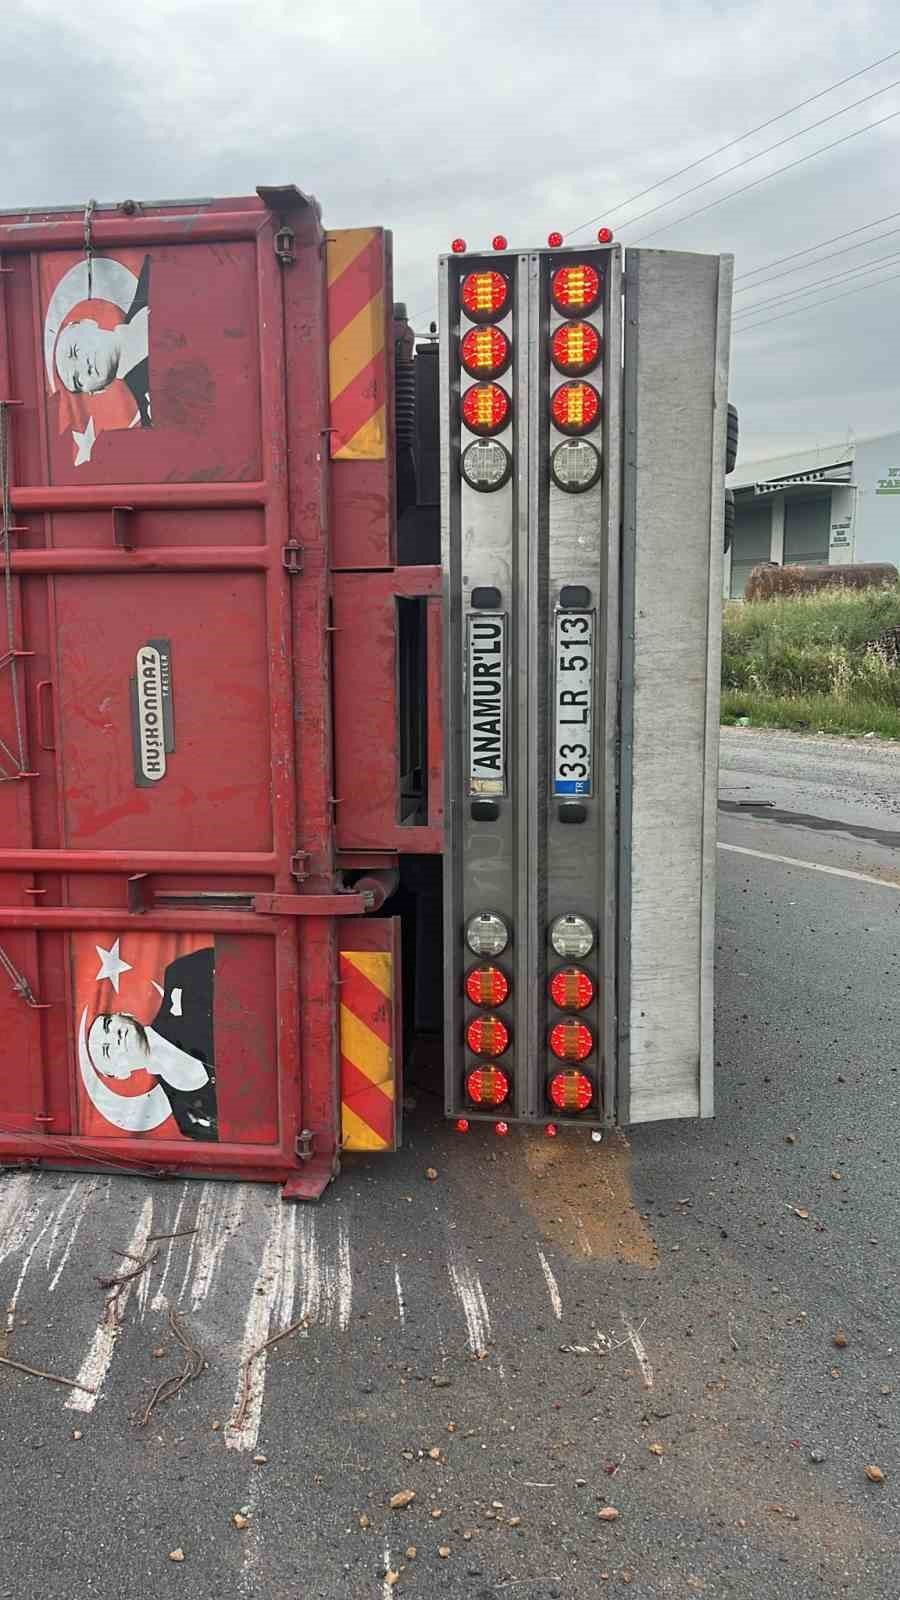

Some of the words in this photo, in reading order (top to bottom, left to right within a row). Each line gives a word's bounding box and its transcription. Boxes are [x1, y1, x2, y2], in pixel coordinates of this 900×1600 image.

[560, 617, 589, 671] 513
[142, 654, 162, 772] KUŞKONMAZ
[473, 623, 501, 771] ANAMUR'LU
[560, 690, 588, 724] LR
[560, 744, 587, 777] 33
[575, 782, 584, 793] TR
